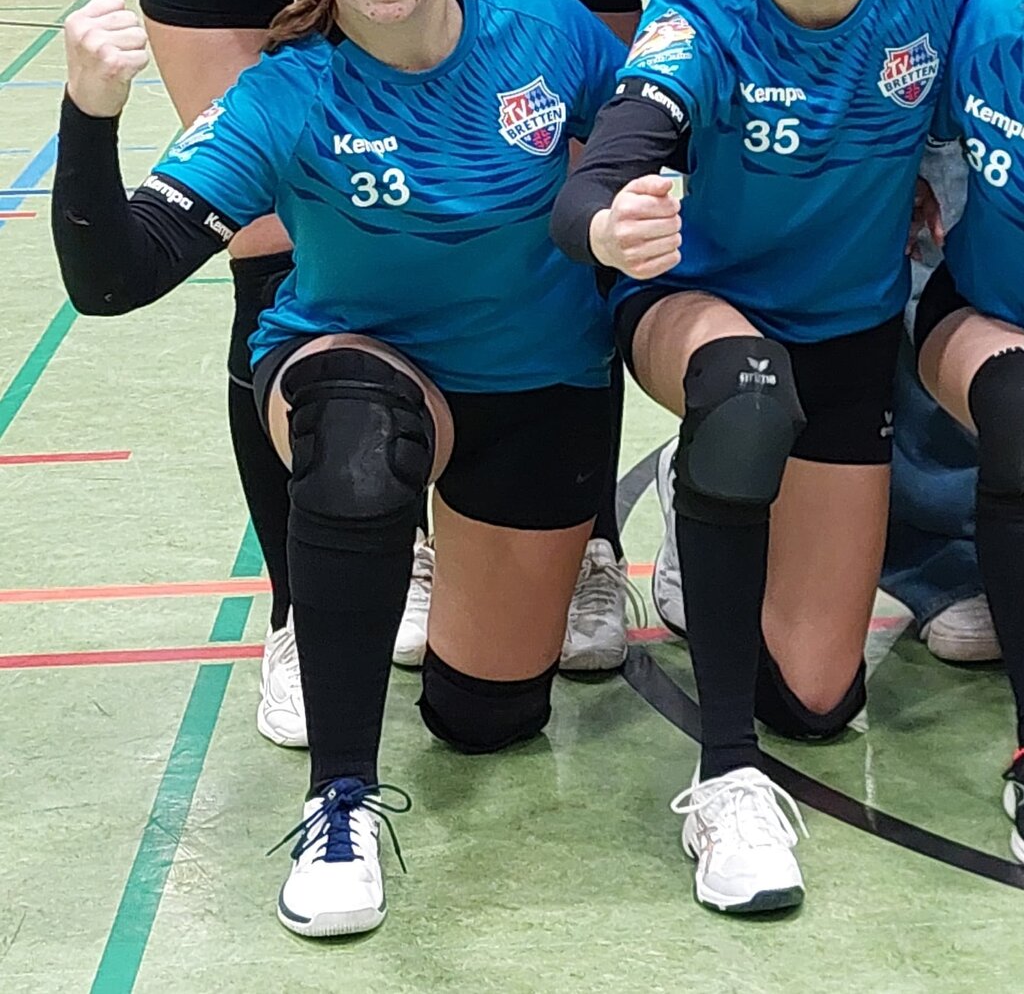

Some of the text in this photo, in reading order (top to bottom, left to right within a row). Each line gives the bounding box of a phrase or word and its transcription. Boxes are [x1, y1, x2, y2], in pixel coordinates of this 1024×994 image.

[740, 82, 807, 107] Kempa
[884, 64, 938, 92] BRETTEN
[506, 102, 532, 124] TV
[506, 107, 563, 141] BRETTEN
[743, 117, 801, 155] 35
[965, 137, 1012, 187] 38
[143, 175, 194, 211] Kempa
[350, 167, 411, 207] 33
[203, 211, 235, 242] Kemp
